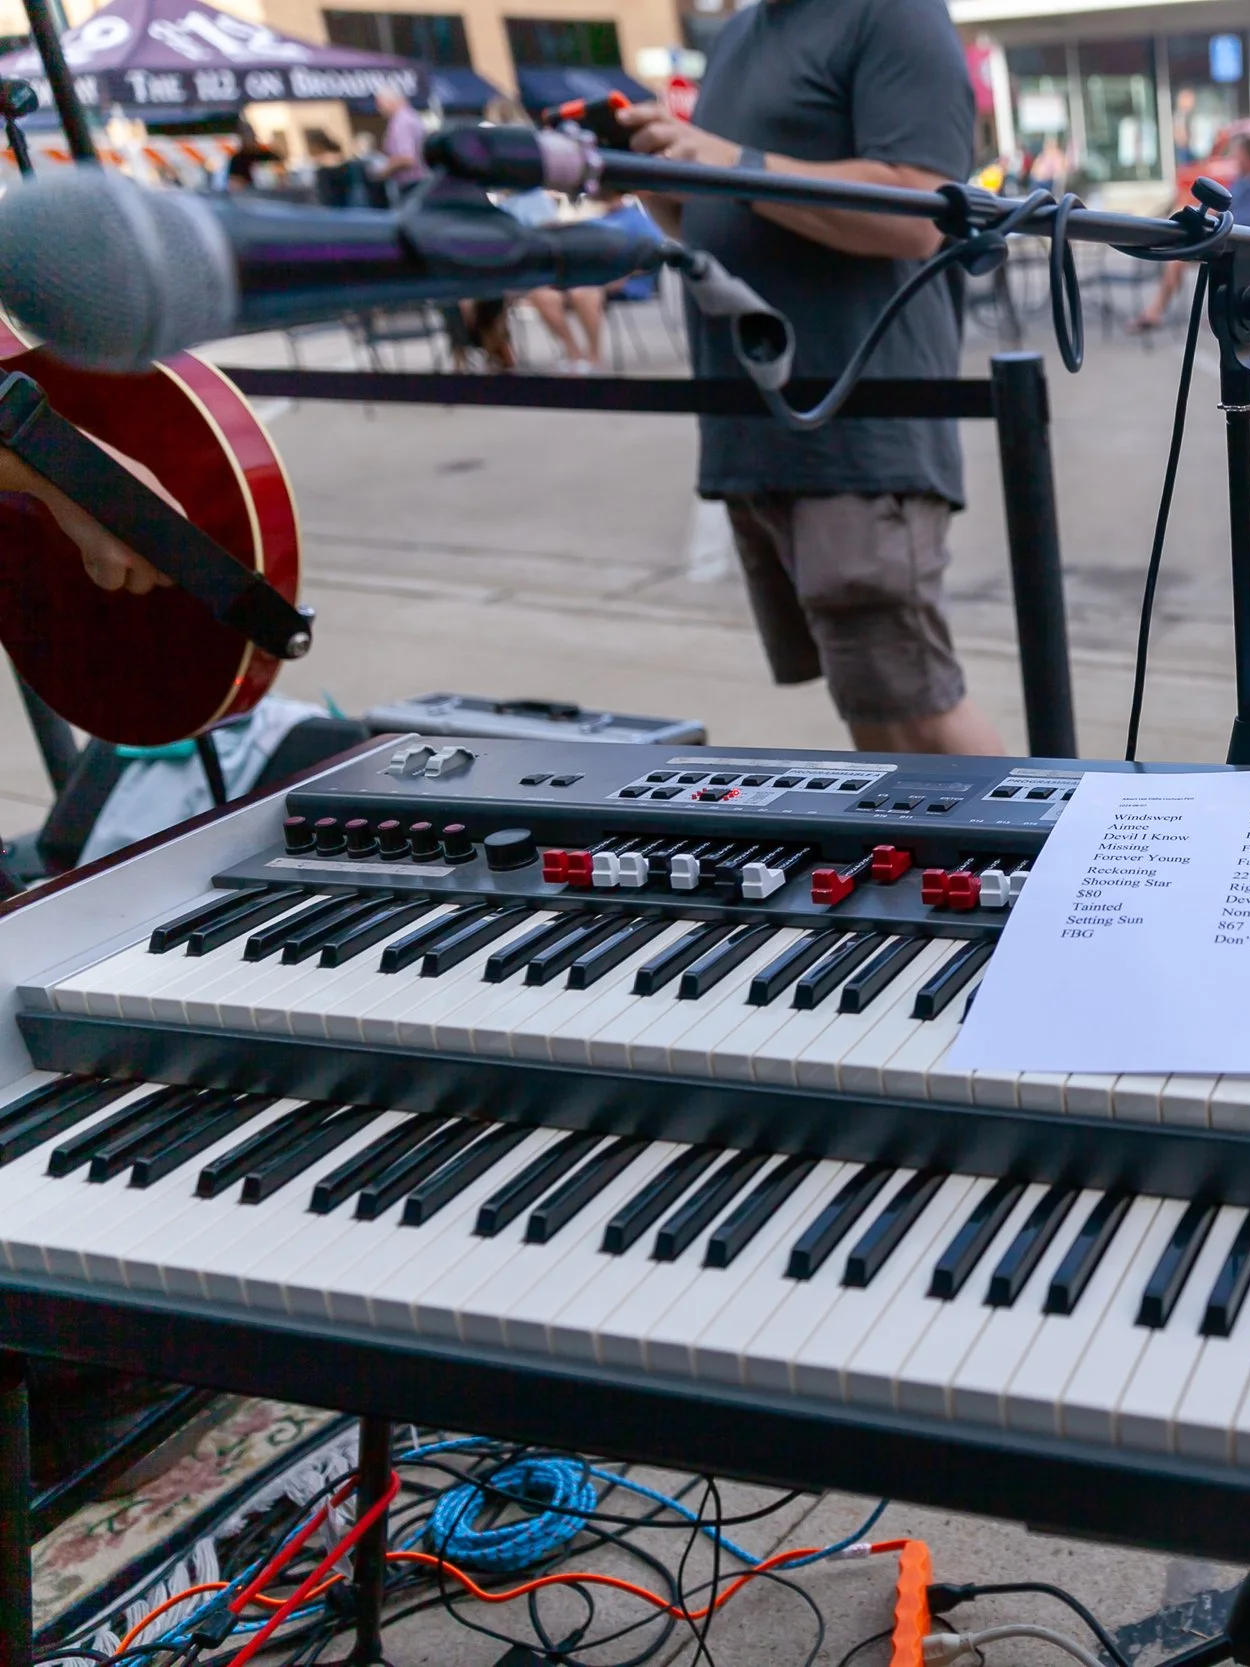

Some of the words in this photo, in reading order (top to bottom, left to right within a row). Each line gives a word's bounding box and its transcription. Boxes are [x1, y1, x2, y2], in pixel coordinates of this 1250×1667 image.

[1114, 814, 1182, 822] Windswept
[1151, 833, 1190, 841] Know
[1098, 843, 1150, 852] Missing
[1148, 854, 1190, 864] Young
[1087, 866, 1157, 877] Reckoning
[1232, 872, 1249, 880] 22
[1081, 877, 1140, 888] Shooting
[1144, 879, 1172, 888] Star
[1076, 889, 1102, 899] $80
[1073, 902, 1123, 911] Tainted
[1066, 915, 1114, 927] Setting
[1117, 915, 1144, 925] Sun
[1218, 921, 1244, 931] 867
[1060, 929, 1094, 938] FBG
